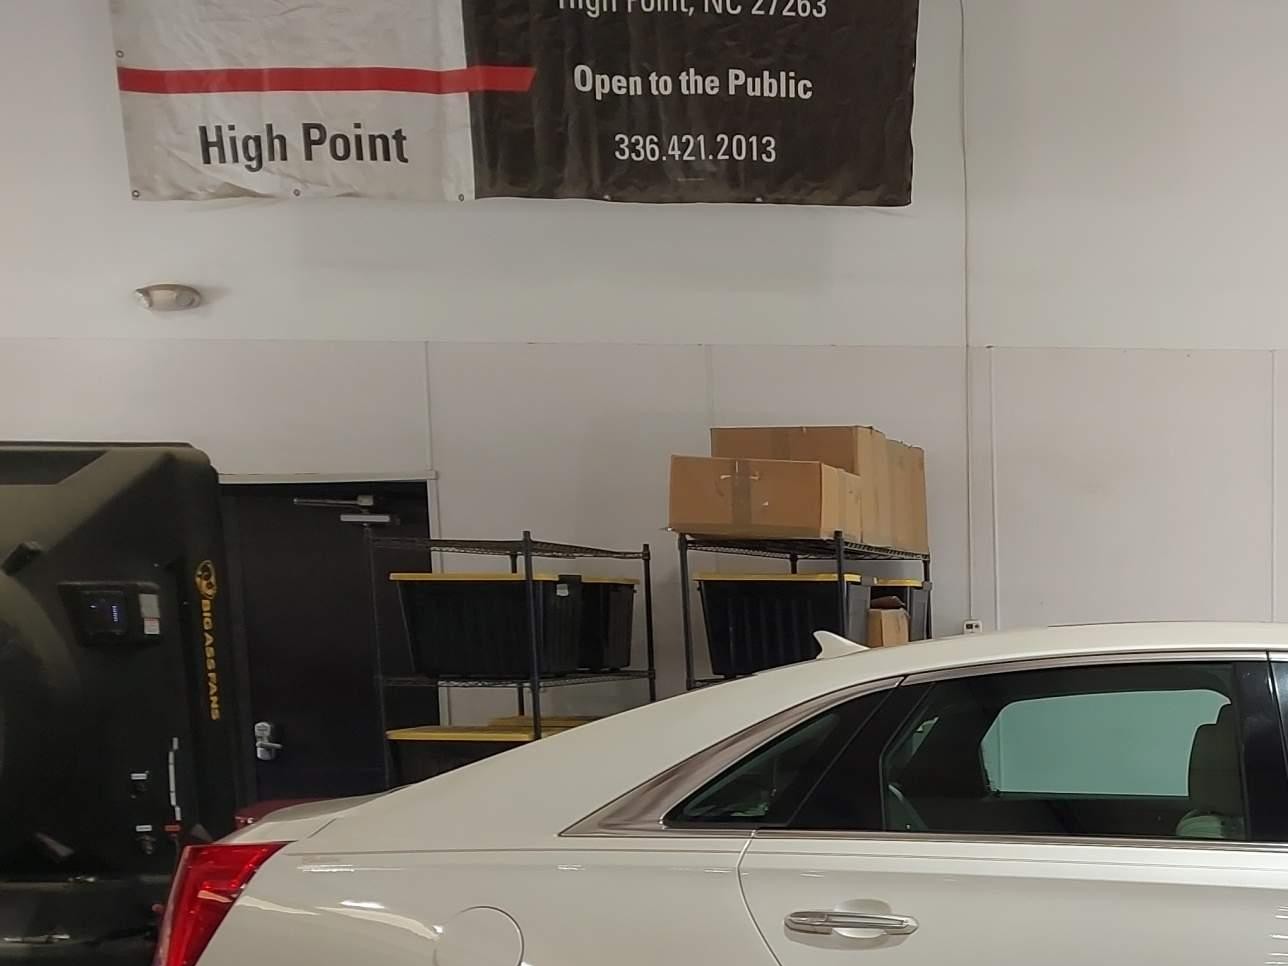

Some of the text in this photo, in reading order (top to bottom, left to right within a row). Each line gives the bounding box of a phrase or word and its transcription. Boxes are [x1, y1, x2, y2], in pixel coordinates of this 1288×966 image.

[751, 0, 827, 18] 27263
[573, 64, 813, 100] Open to the Public
[198, 122, 409, 173] High Point
[614, 133, 776, 162] 336.421.2013
